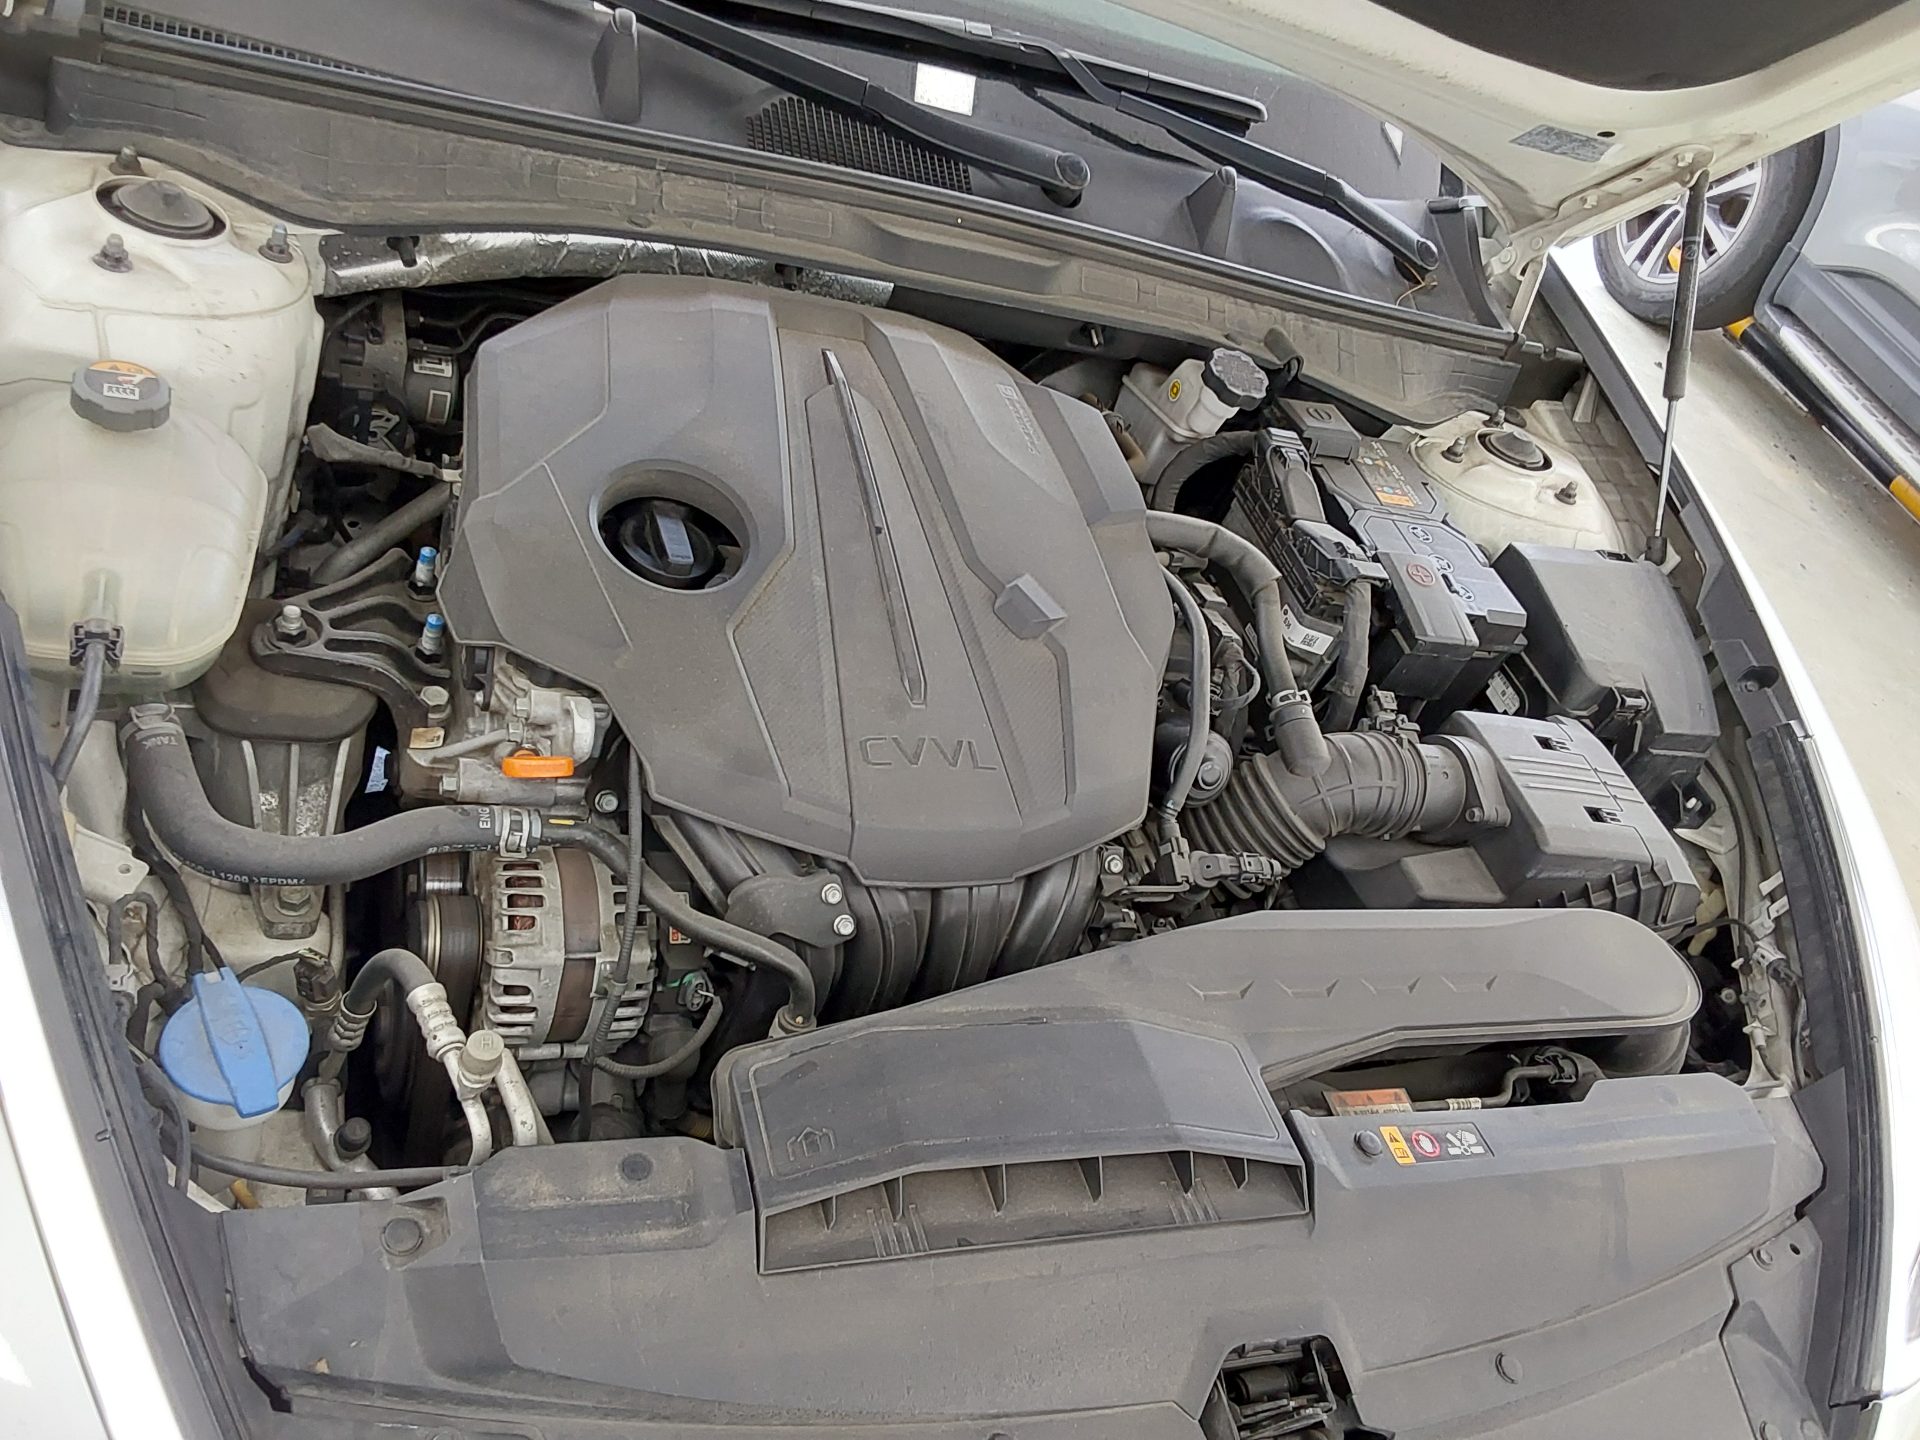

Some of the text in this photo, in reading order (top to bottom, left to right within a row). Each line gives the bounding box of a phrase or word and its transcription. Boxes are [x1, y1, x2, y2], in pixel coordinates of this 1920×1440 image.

[141, 735, 179, 749] TANK
[859, 736, 997, 770] CVVL
[479, 807, 491, 829] ENG
[481, 1035, 493, 1049] H
